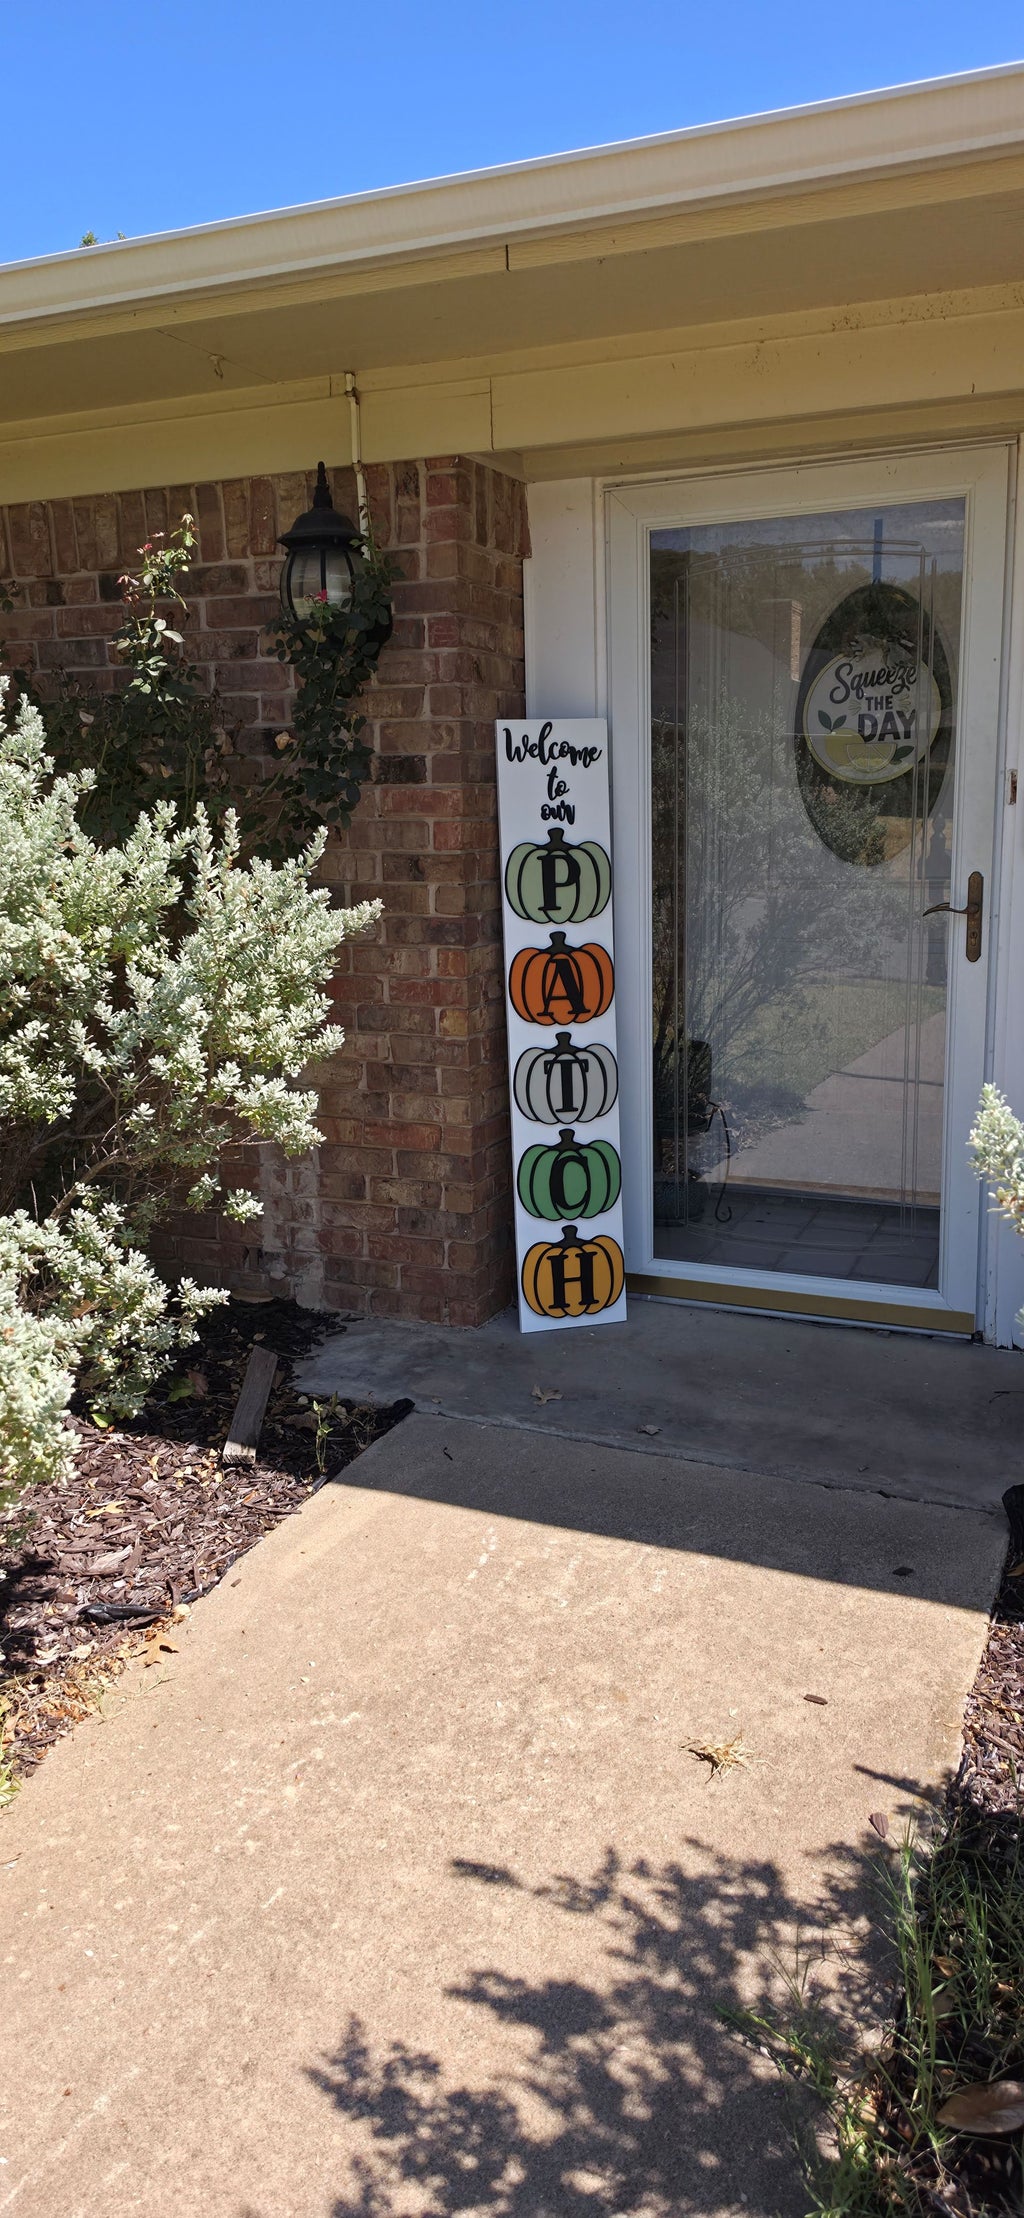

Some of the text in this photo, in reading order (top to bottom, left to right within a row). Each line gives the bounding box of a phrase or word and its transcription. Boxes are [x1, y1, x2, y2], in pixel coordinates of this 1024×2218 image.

[829, 660, 917, 704] Squeeze
[865, 695, 894, 711] THE
[858, 709, 916, 743] DAY
[503, 721, 602, 768] Welcome
[546, 766, 570, 801] to
[540, 800, 576, 825] our
